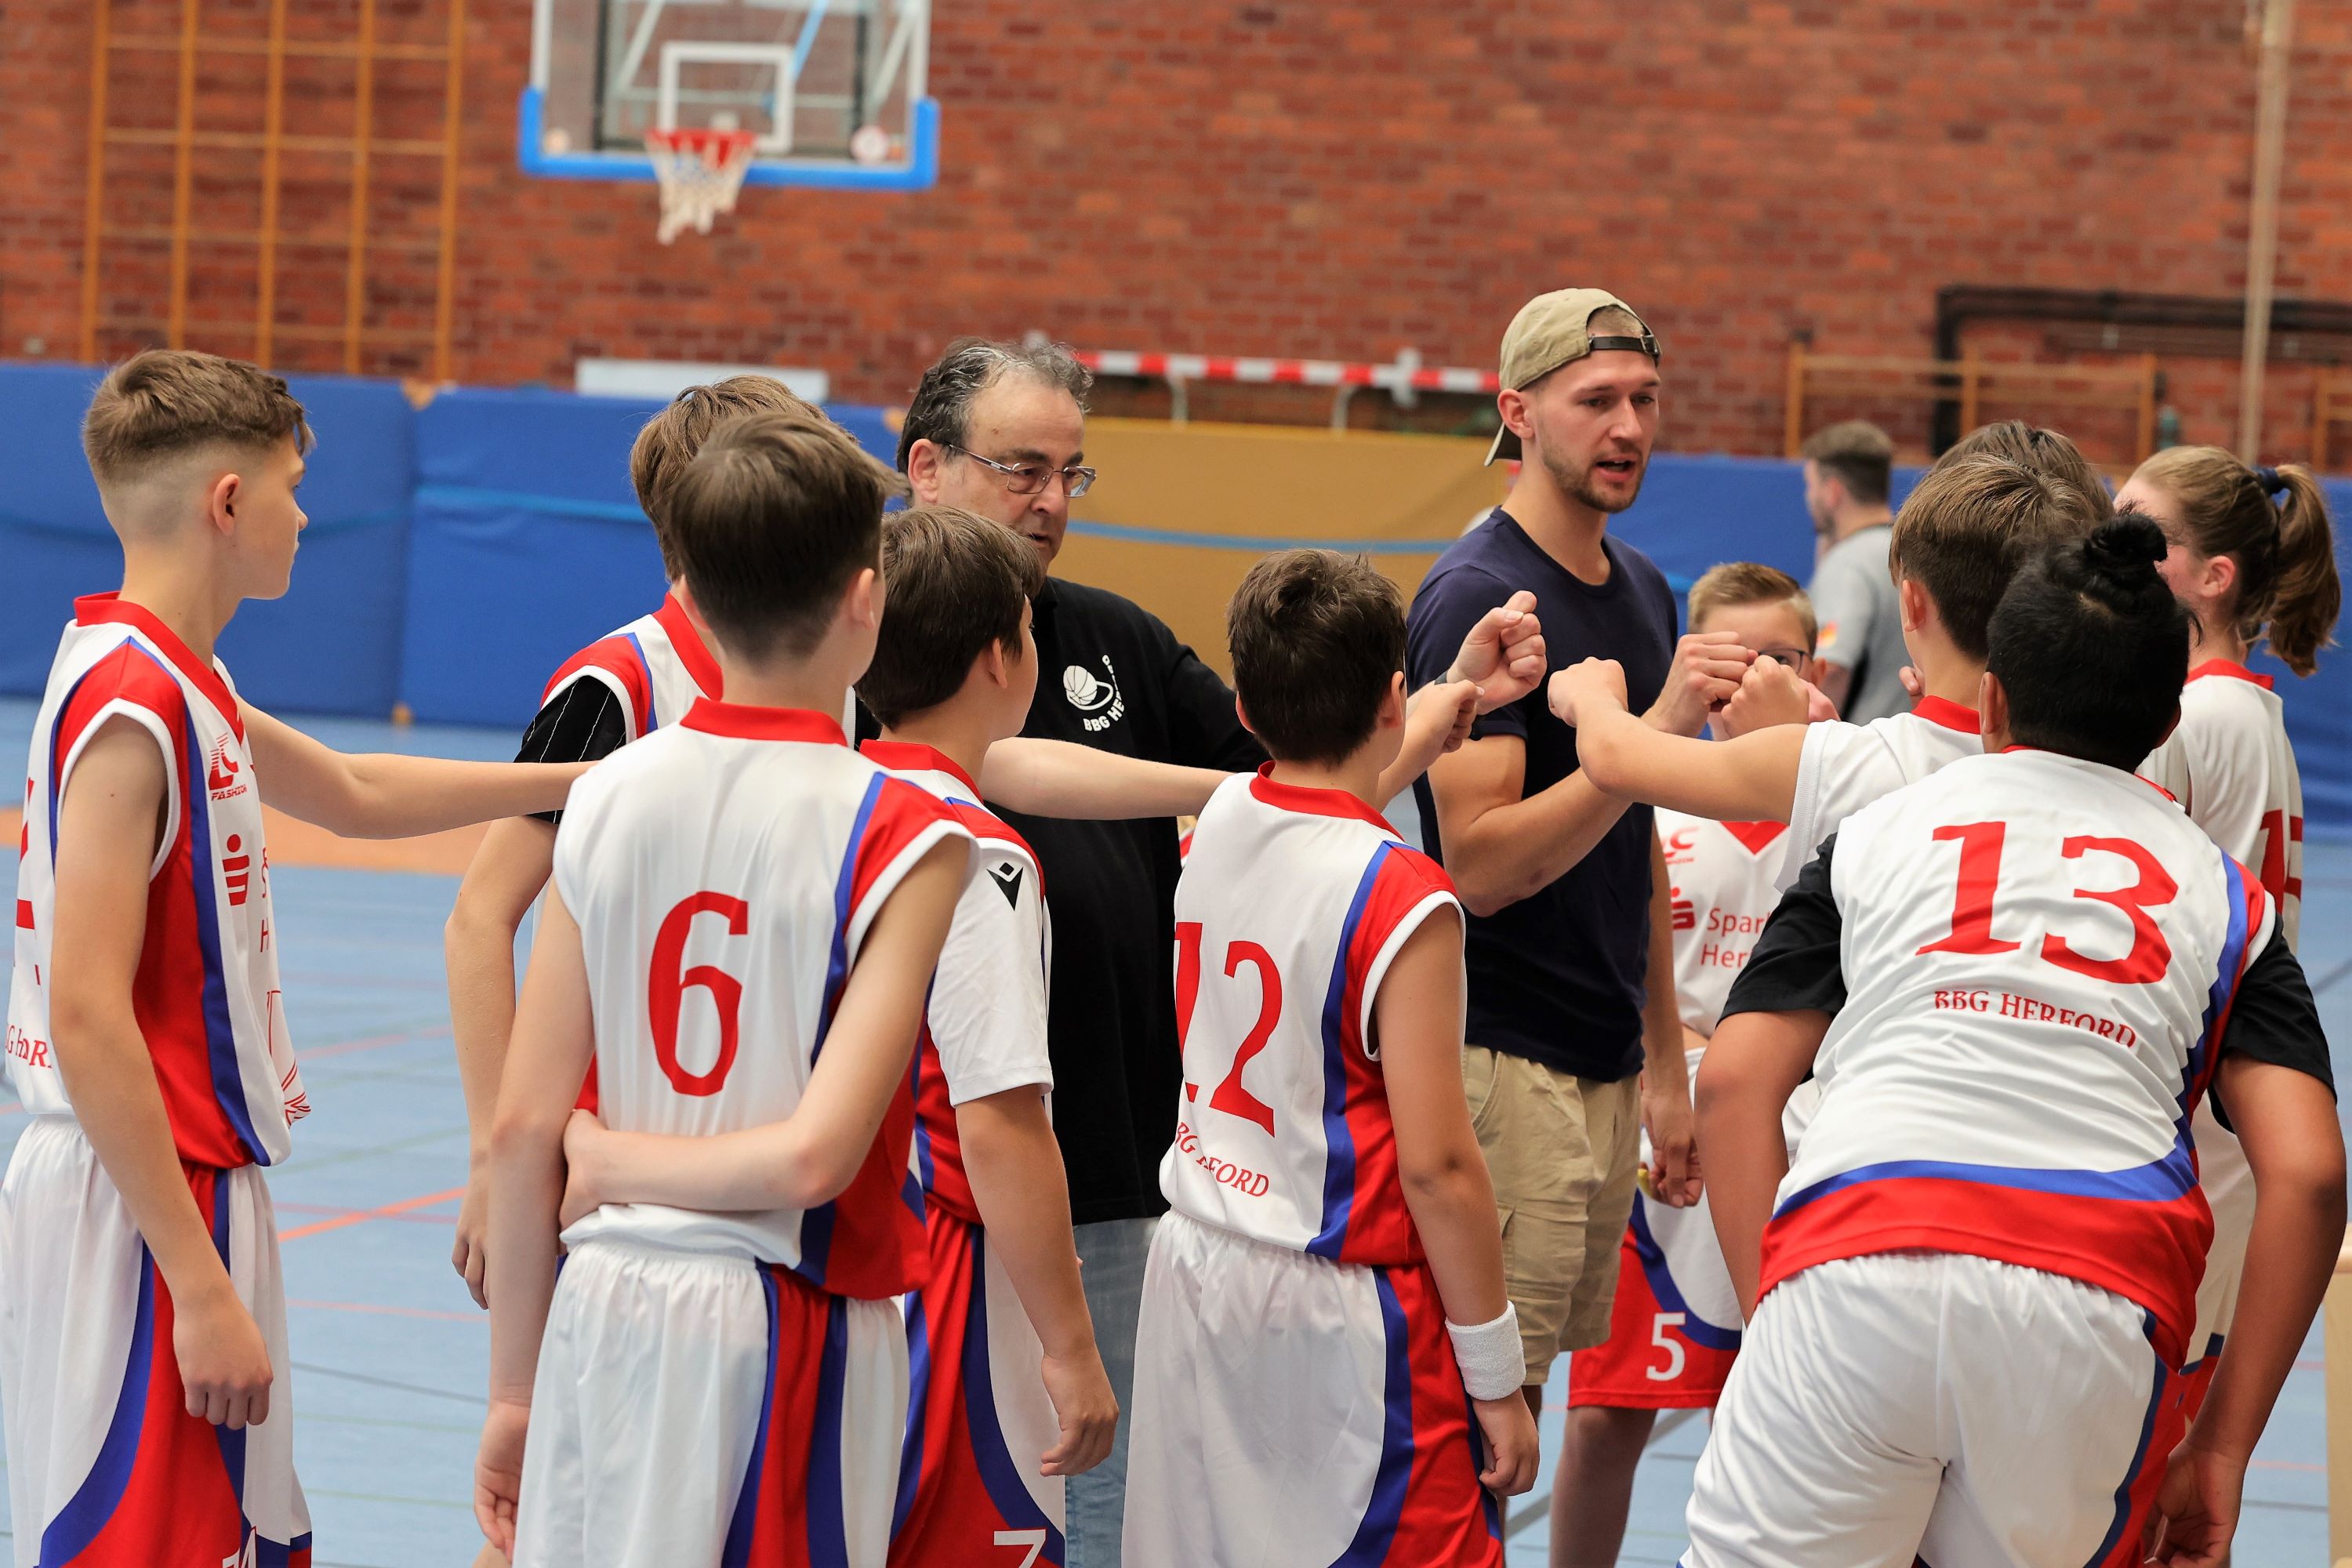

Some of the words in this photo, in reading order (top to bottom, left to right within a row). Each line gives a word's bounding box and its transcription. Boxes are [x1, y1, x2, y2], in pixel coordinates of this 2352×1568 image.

[1083, 715, 1111, 731] BBG
[1707, 907, 1773, 938] Spar
[1915, 821, 2179, 985] 13
[648, 891, 749, 1097] 6
[1934, 990, 1990, 1013] BBG
[1998, 993, 2137, 1048] HERFORD
[1646, 1312, 1686, 1382] 5
